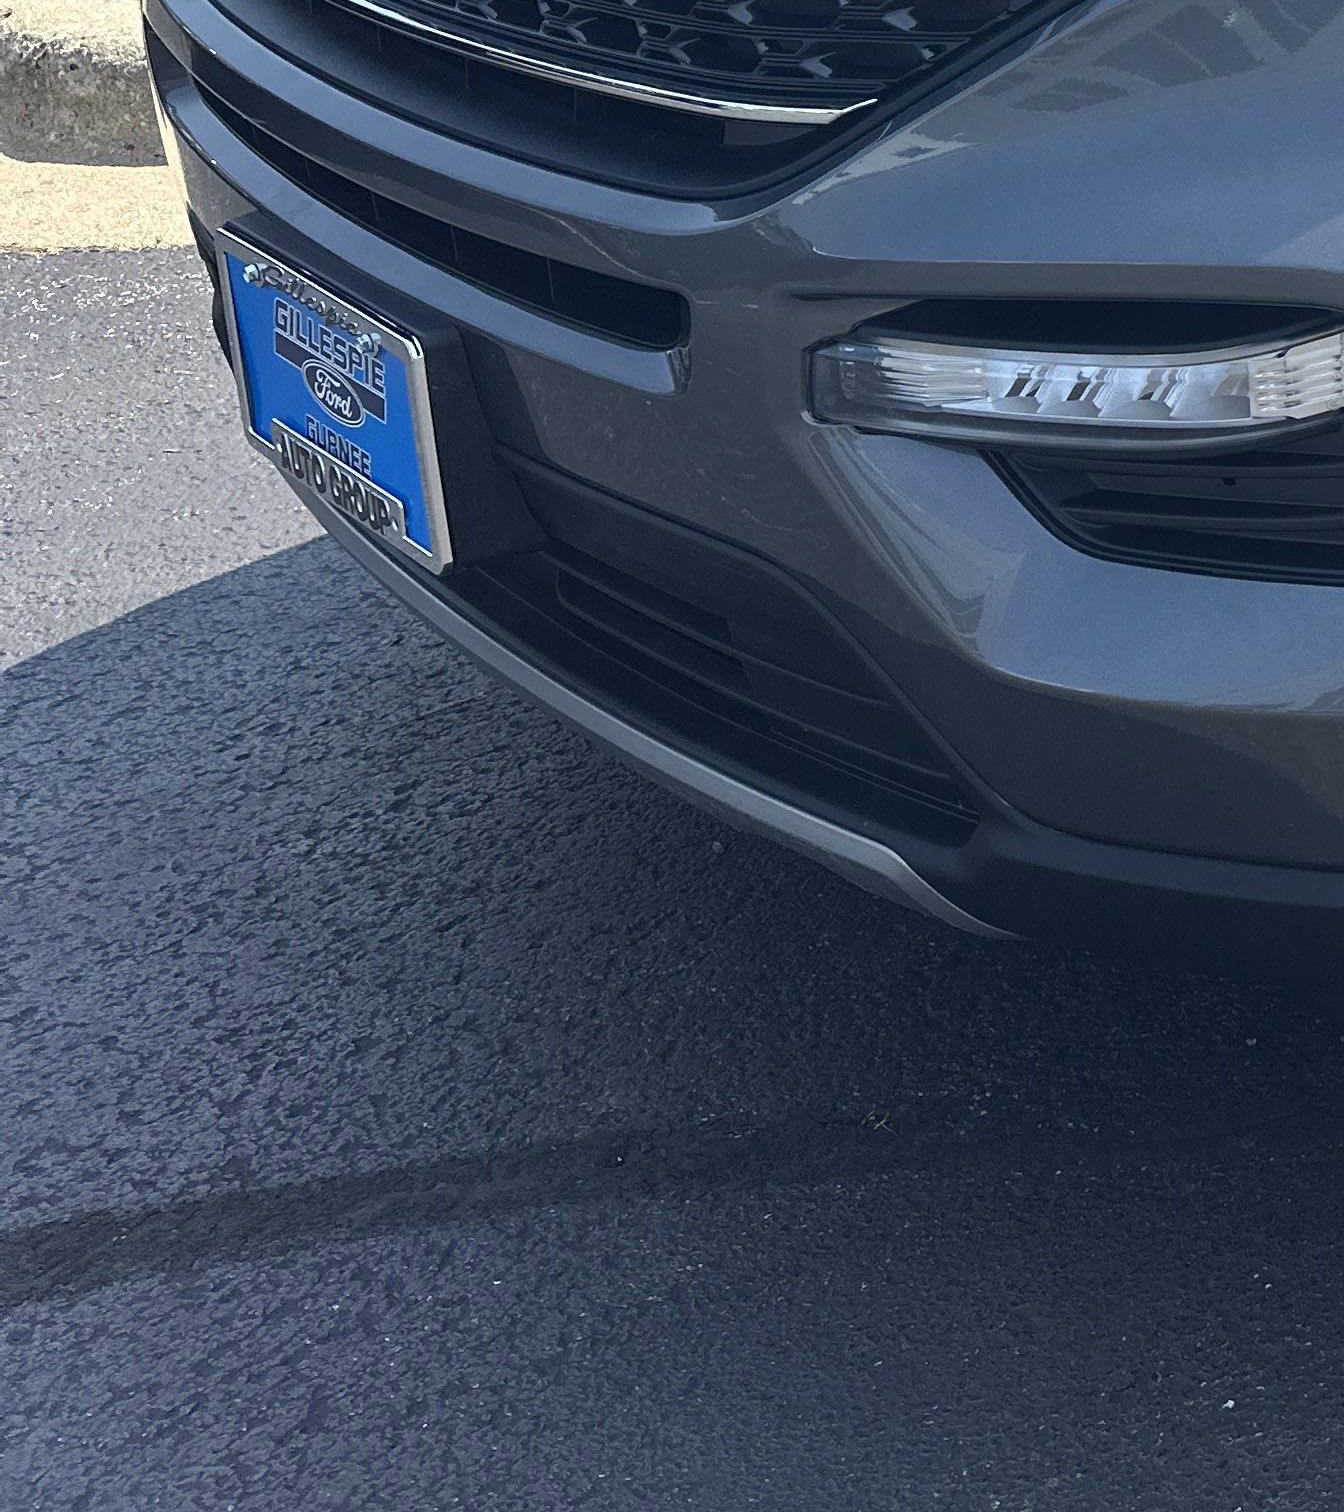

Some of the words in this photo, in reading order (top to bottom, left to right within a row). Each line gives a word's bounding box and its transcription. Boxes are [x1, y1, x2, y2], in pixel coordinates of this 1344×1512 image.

[273, 296, 387, 396] GILLESPIE
[314, 368, 353, 418] Ford
[281, 431, 327, 494] AUTO
[328, 463, 392, 536] GROUP
[304, 412, 373, 479] GURNEE
